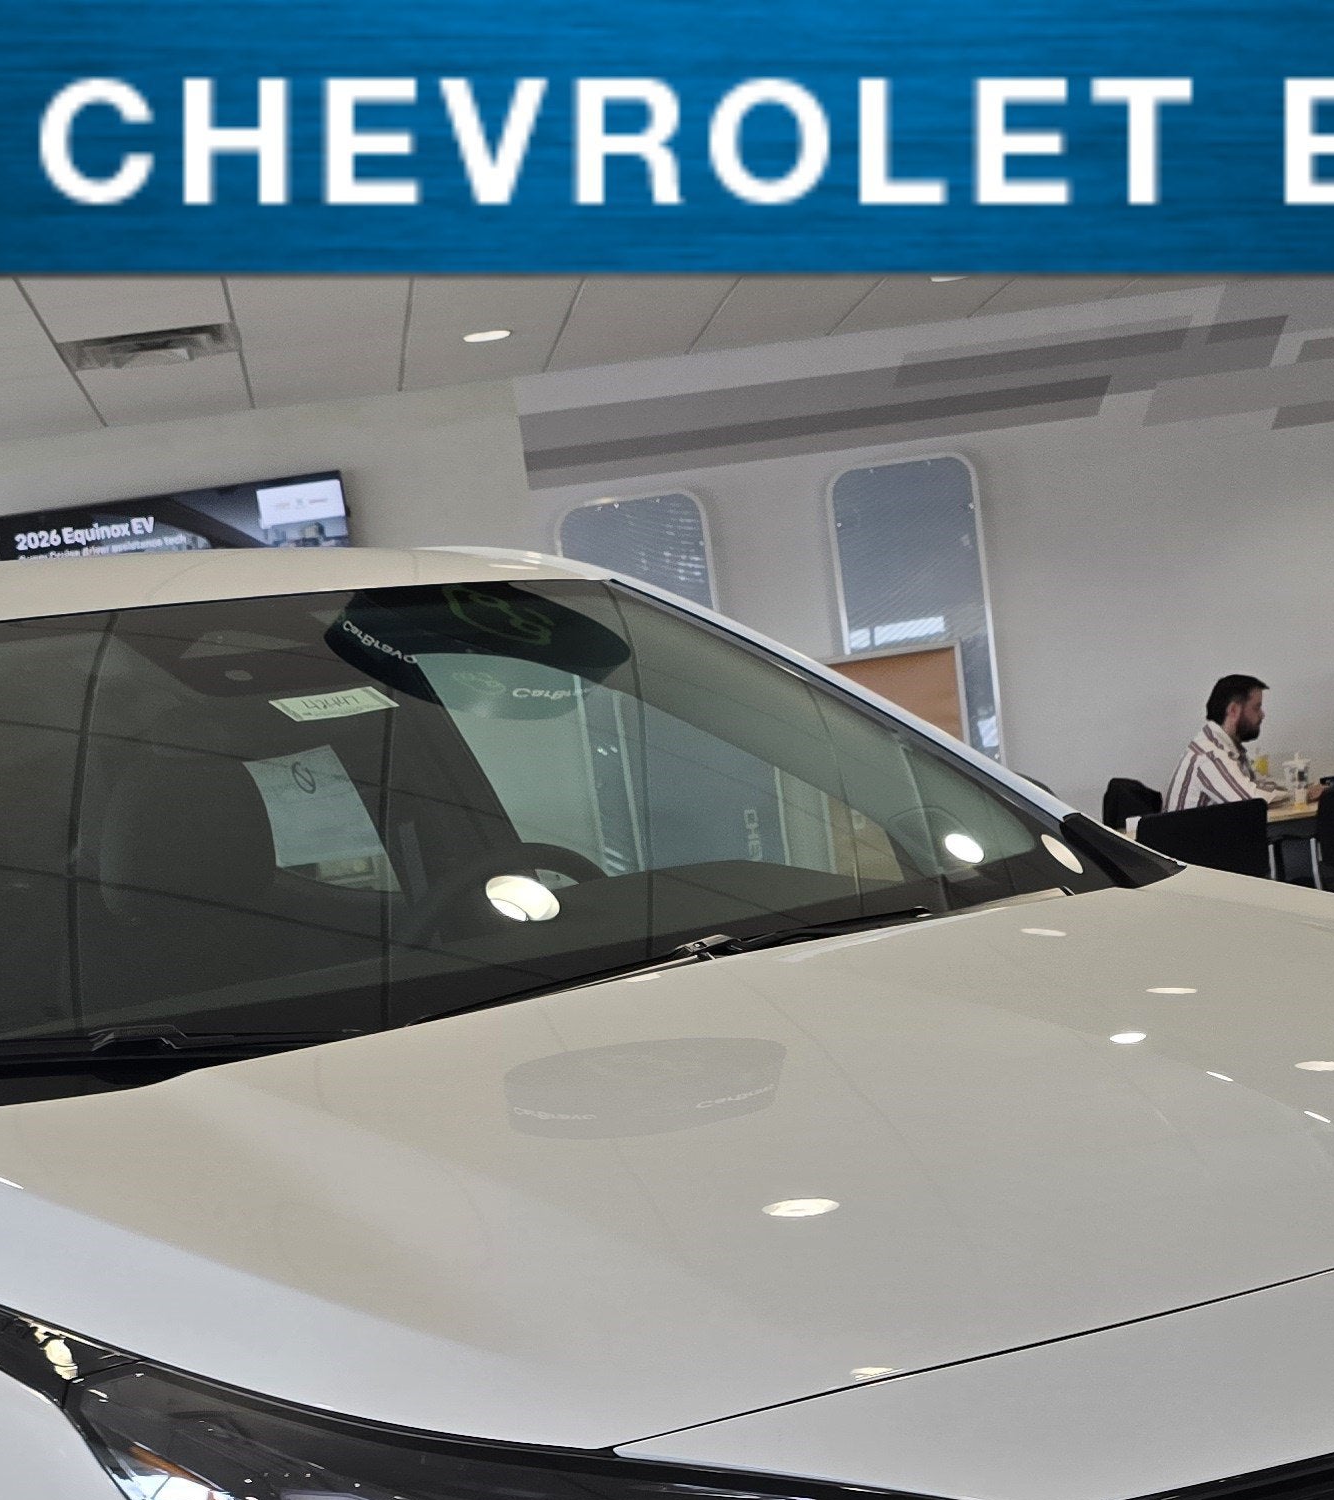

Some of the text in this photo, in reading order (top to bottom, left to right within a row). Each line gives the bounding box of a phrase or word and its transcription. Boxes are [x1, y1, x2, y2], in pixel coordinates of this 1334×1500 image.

[14, 516, 155, 551] 2026 Equinox EV
